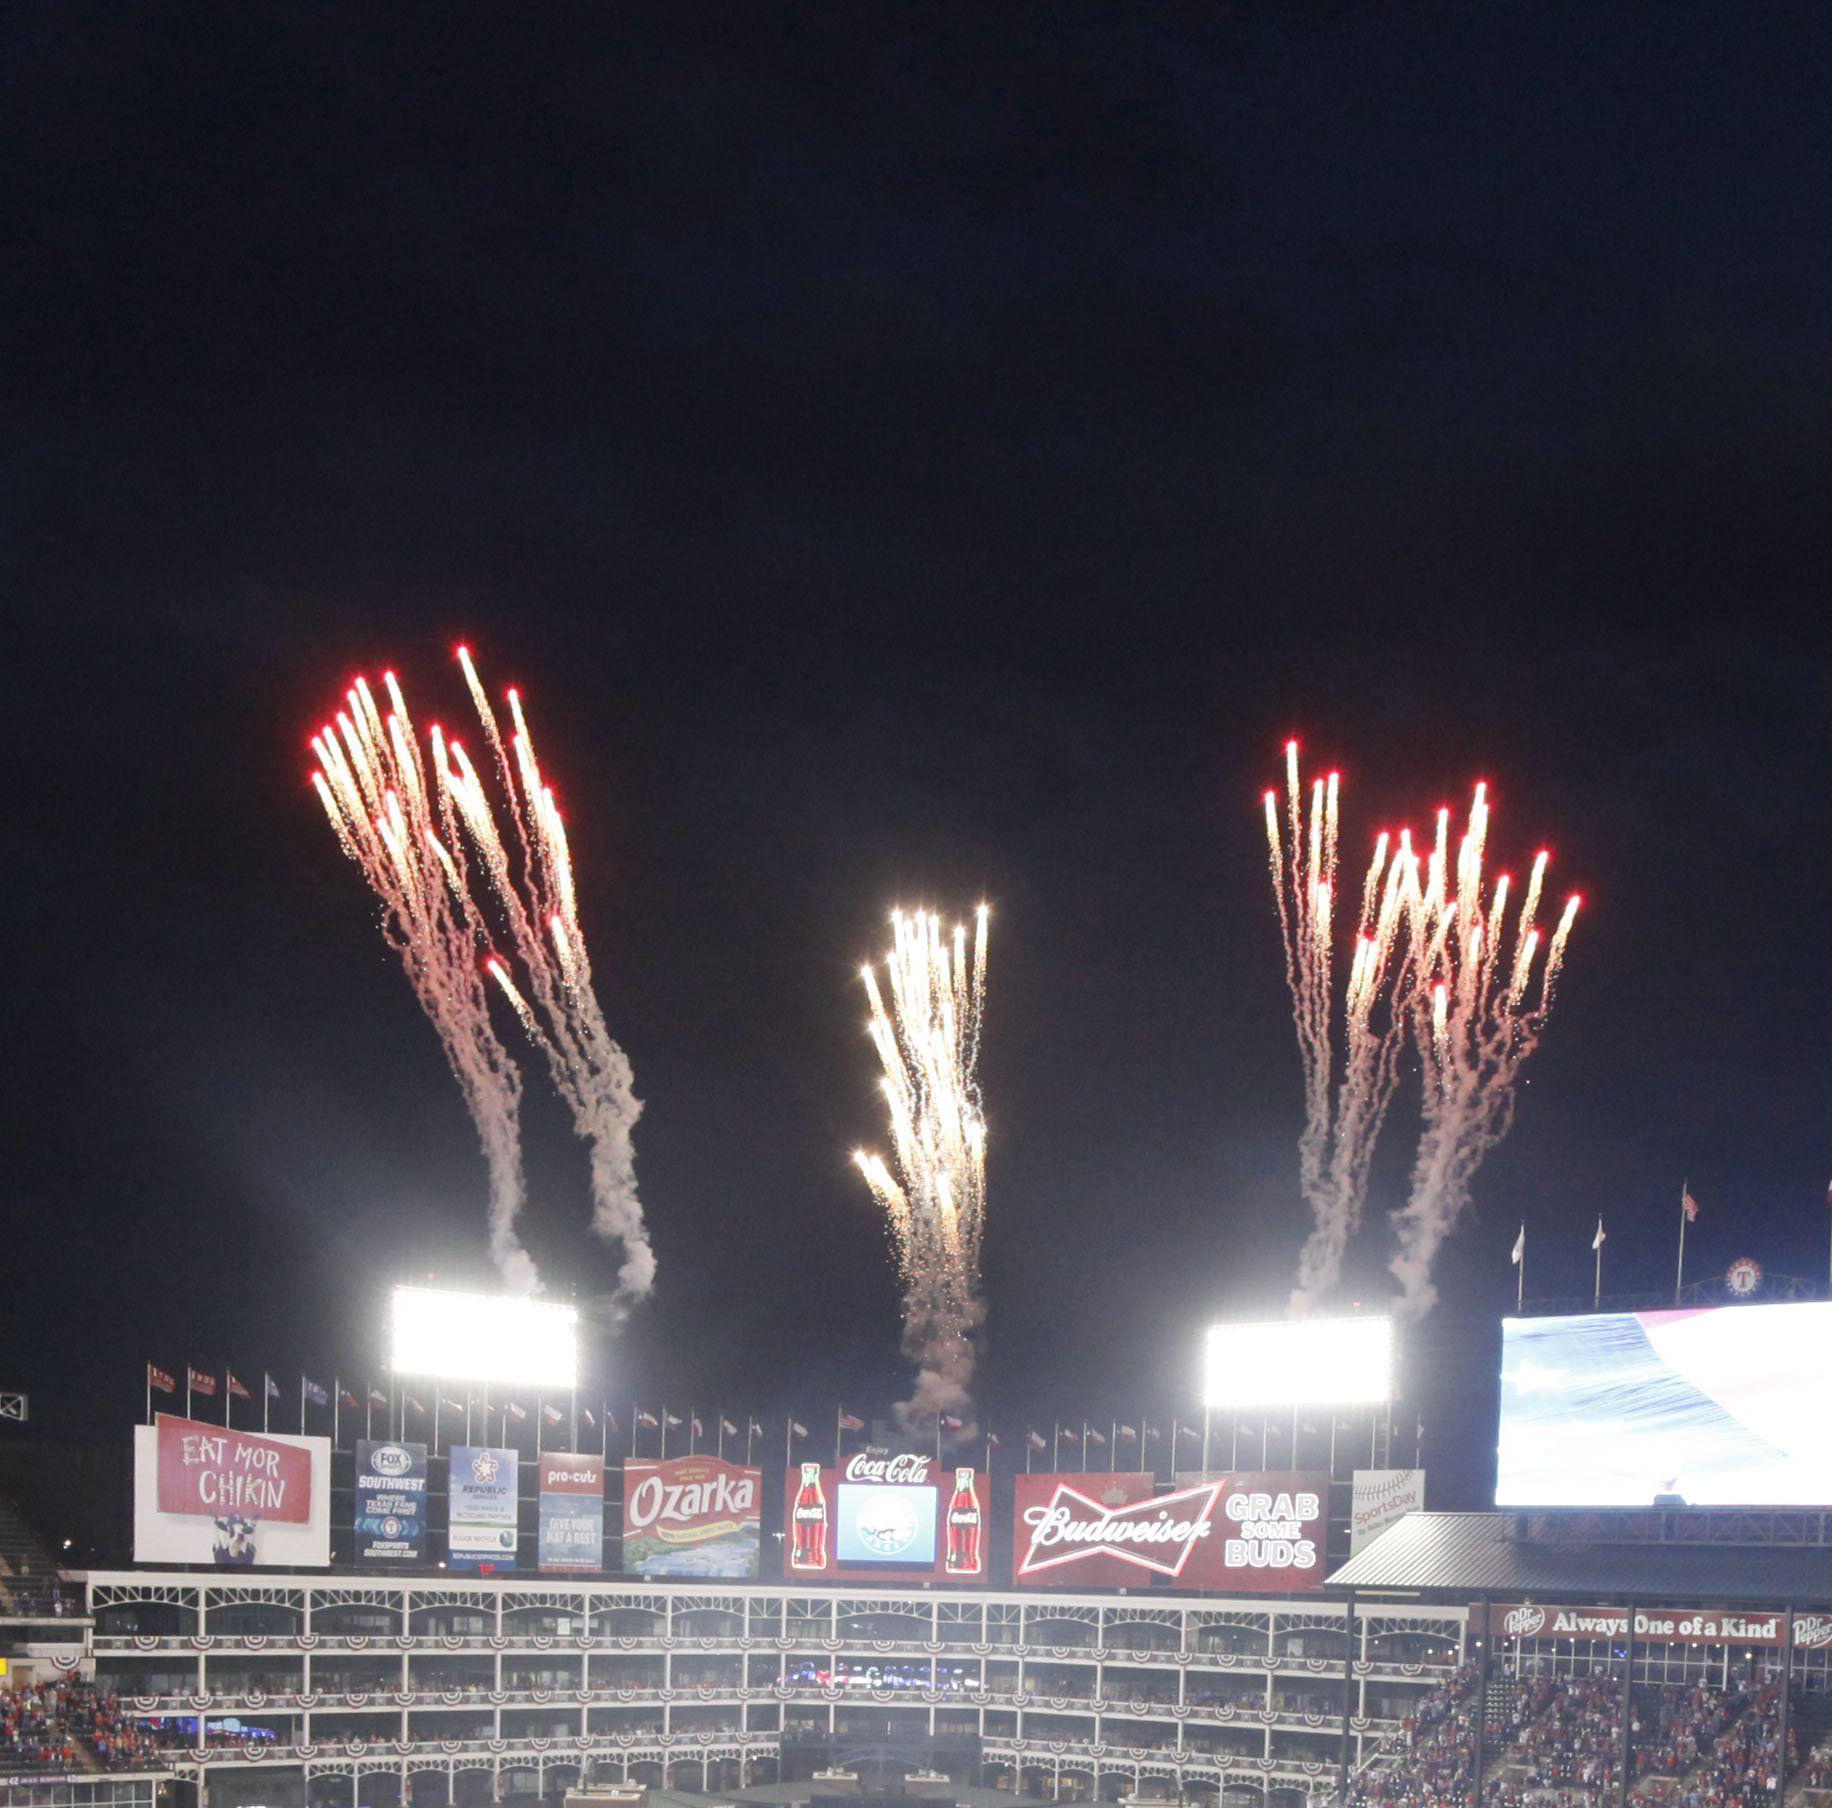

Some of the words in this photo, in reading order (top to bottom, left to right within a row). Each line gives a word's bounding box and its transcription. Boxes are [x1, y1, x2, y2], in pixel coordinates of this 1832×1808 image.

[181, 1435, 227, 1466] EAT
[235, 1443, 280, 1478] MOR
[380, 1452, 403, 1466] FOX
[846, 1453, 933, 1483] Coca-Cola
[199, 1470, 285, 1509] CHIKIN
[358, 1475, 425, 1491] SOUTHWEST
[462, 1485, 508, 1495] REPUBLIC
[629, 1473, 755, 1527] Ozarka
[1224, 1493, 1319, 1523] GRAB
[1354, 1490, 1416, 1525] SportsDay
[549, 1518, 569, 1531] GIVE
[570, 1519, 595, 1532] YOUR
[1024, 1506, 1211, 1545] Budweiser
[1240, 1521, 1301, 1540] SOME
[573, 1532, 596, 1545] REST
[1224, 1540, 1316, 1568] BUDS
[1508, 1614, 1543, 1634] Pepper
[1519, 1608, 1533, 1620] Dr
[1806, 1616, 1823, 1629] Dr
[1553, 1614, 1628, 1634] Always
[1634, 1614, 1675, 1635] One
[1679, 1616, 1705, 1635] of
[1707, 1621, 1717, 1637] a
[1721, 1618, 1777, 1639] Kind
